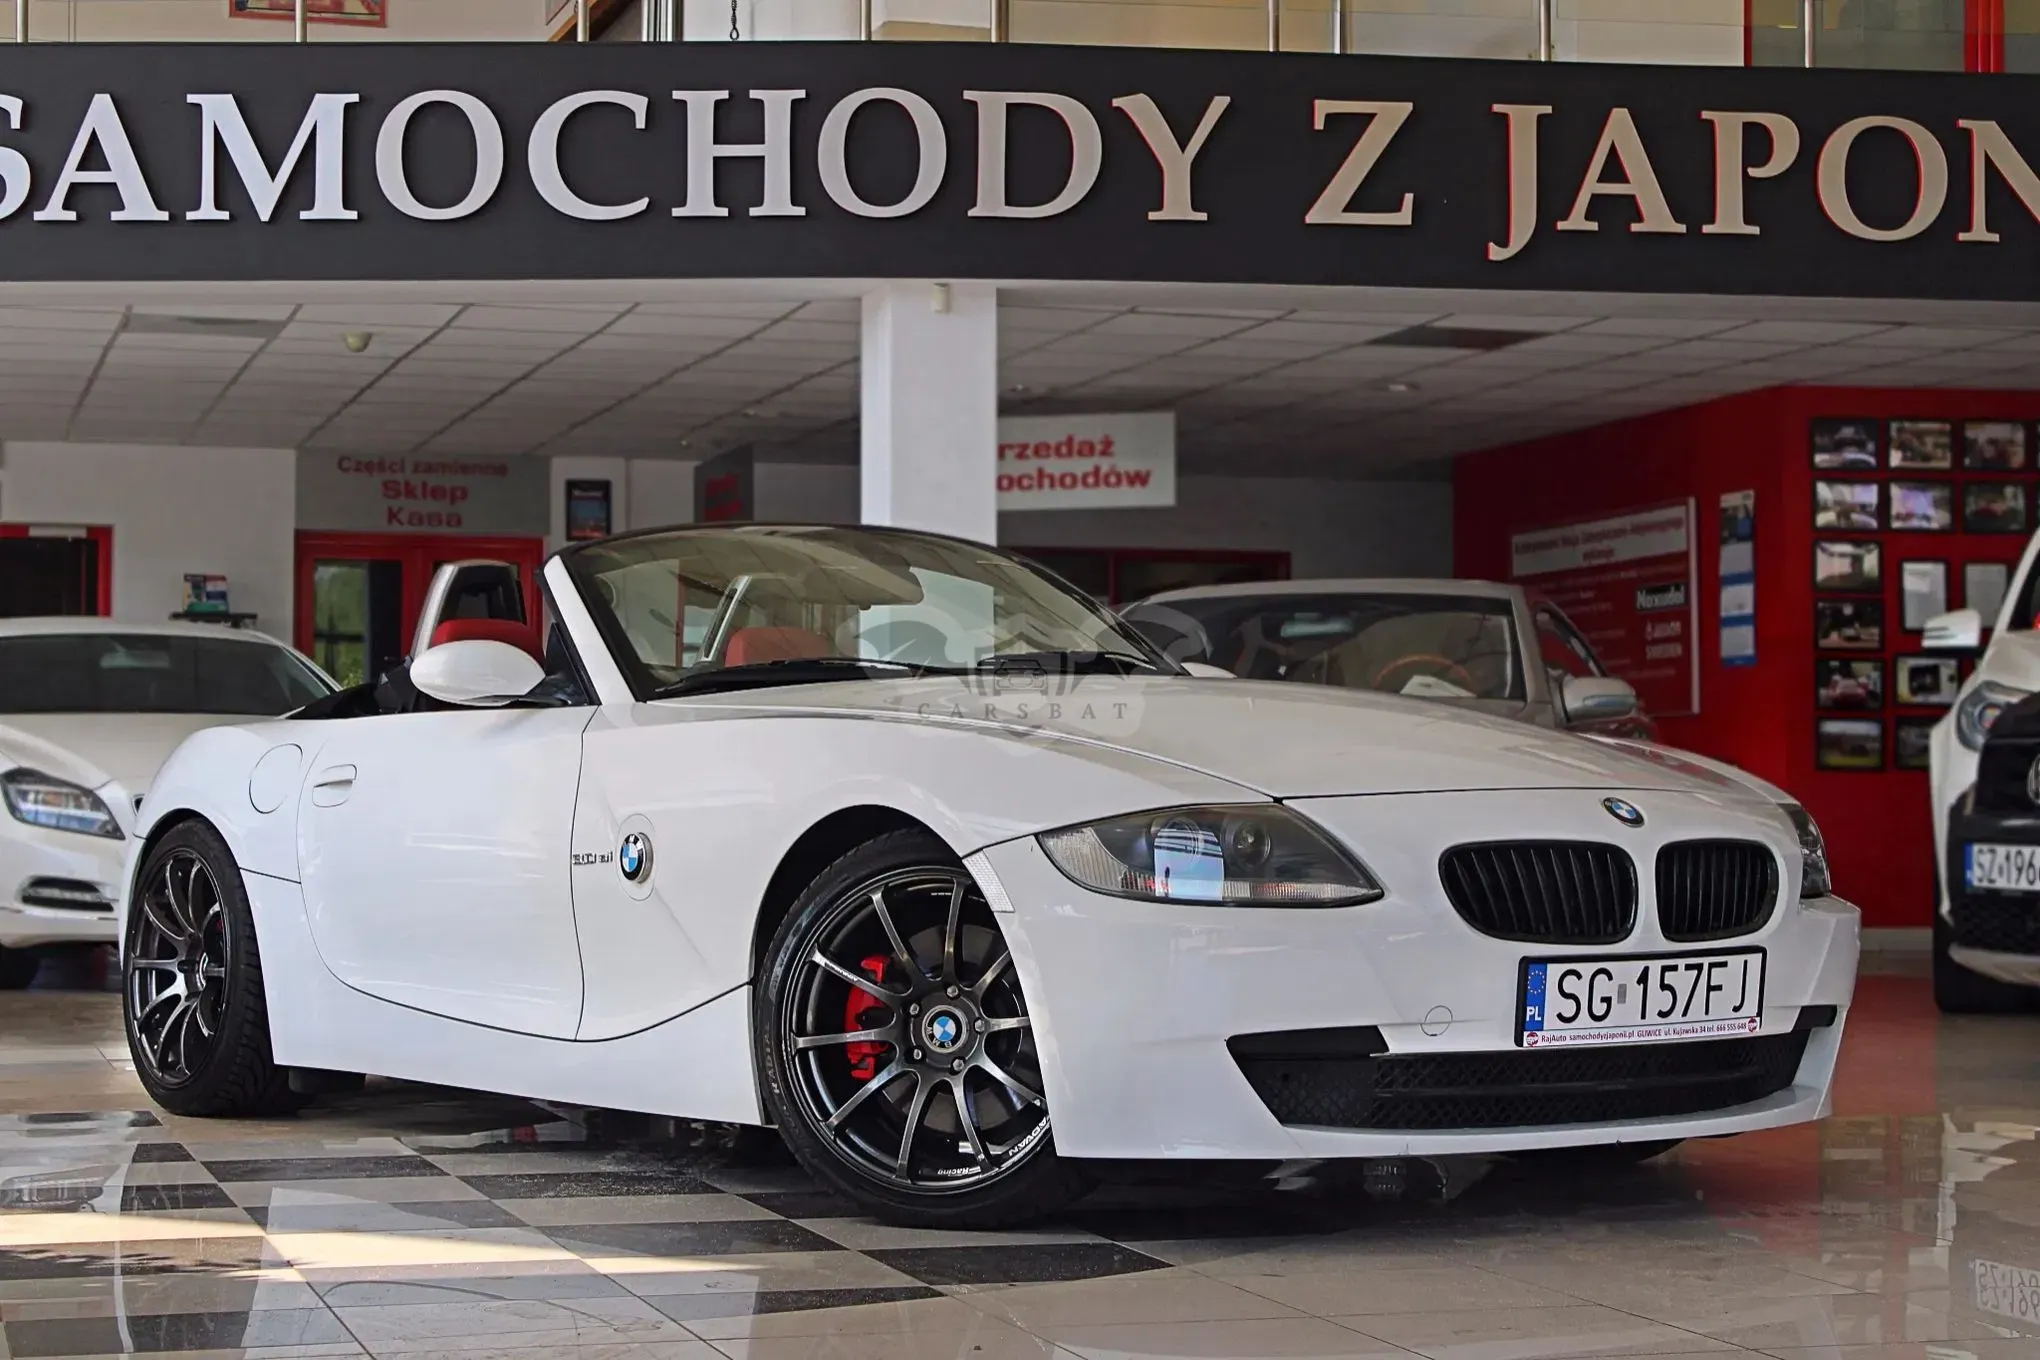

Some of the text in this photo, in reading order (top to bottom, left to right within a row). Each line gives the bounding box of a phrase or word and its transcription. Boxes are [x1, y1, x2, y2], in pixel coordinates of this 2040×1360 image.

[1305, 99, 1414, 225] Z
[997, 463, 1152, 492] ochodów
[382, 479, 469, 505] Sklep
[387, 506, 463, 528] Kasa
[2004, 848, 2040, 886] 196
[1556, 959, 1748, 1024] SG 157FJ
[1526, 1006, 1541, 1021] PL
[1541, 1034, 1567, 1044] RajAuto
